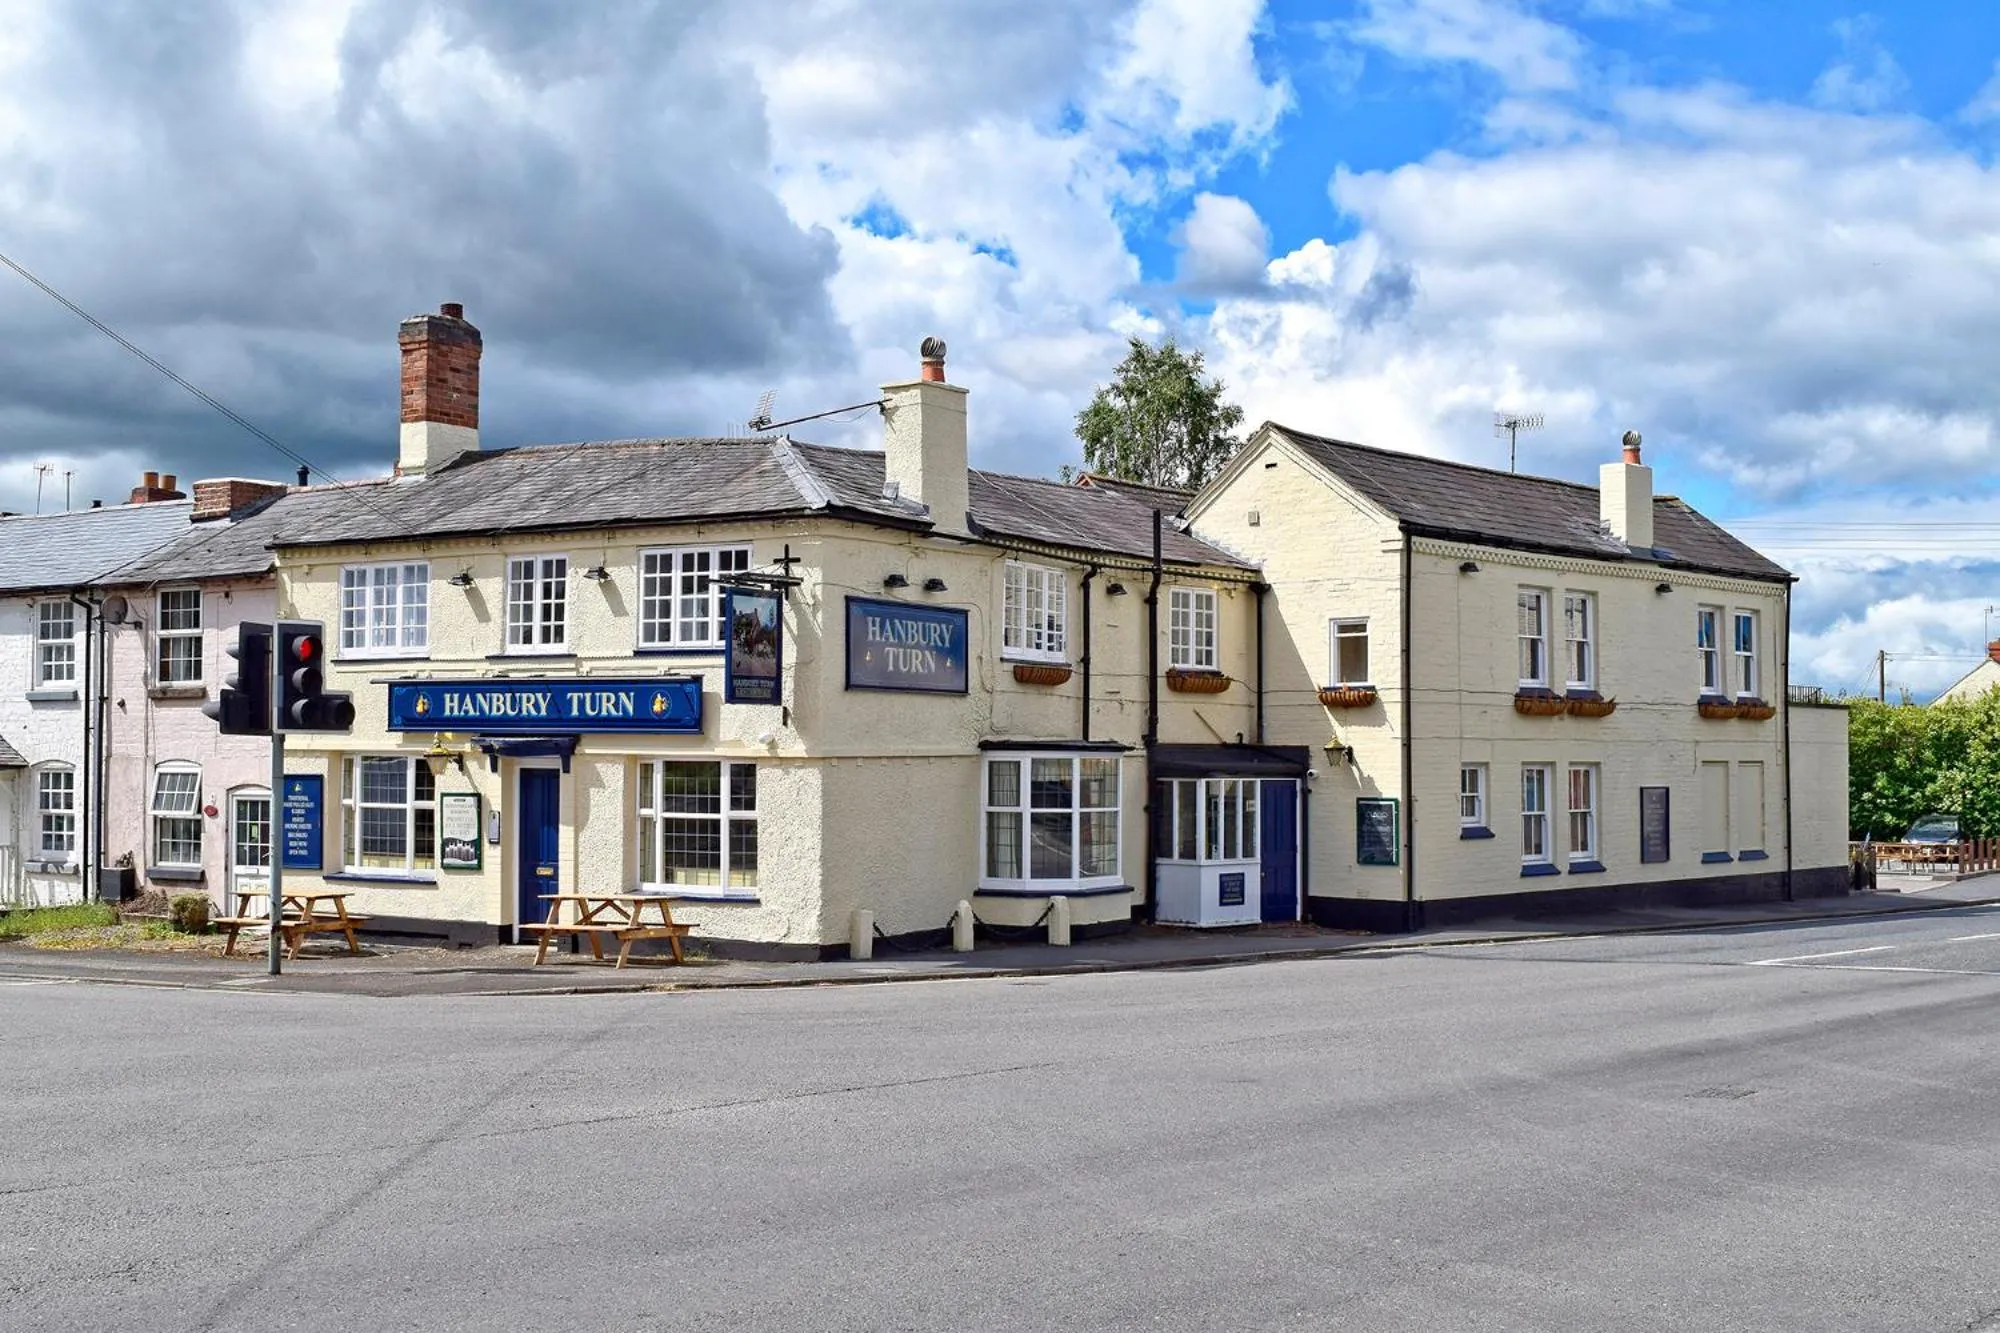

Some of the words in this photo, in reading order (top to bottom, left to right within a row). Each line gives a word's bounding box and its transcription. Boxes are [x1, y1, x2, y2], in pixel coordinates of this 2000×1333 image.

[866, 616, 953, 648] HANBURY
[884, 647, 937, 673] TURN
[443, 692, 552, 717] HANBURY
[566, 692, 635, 717] TURN
